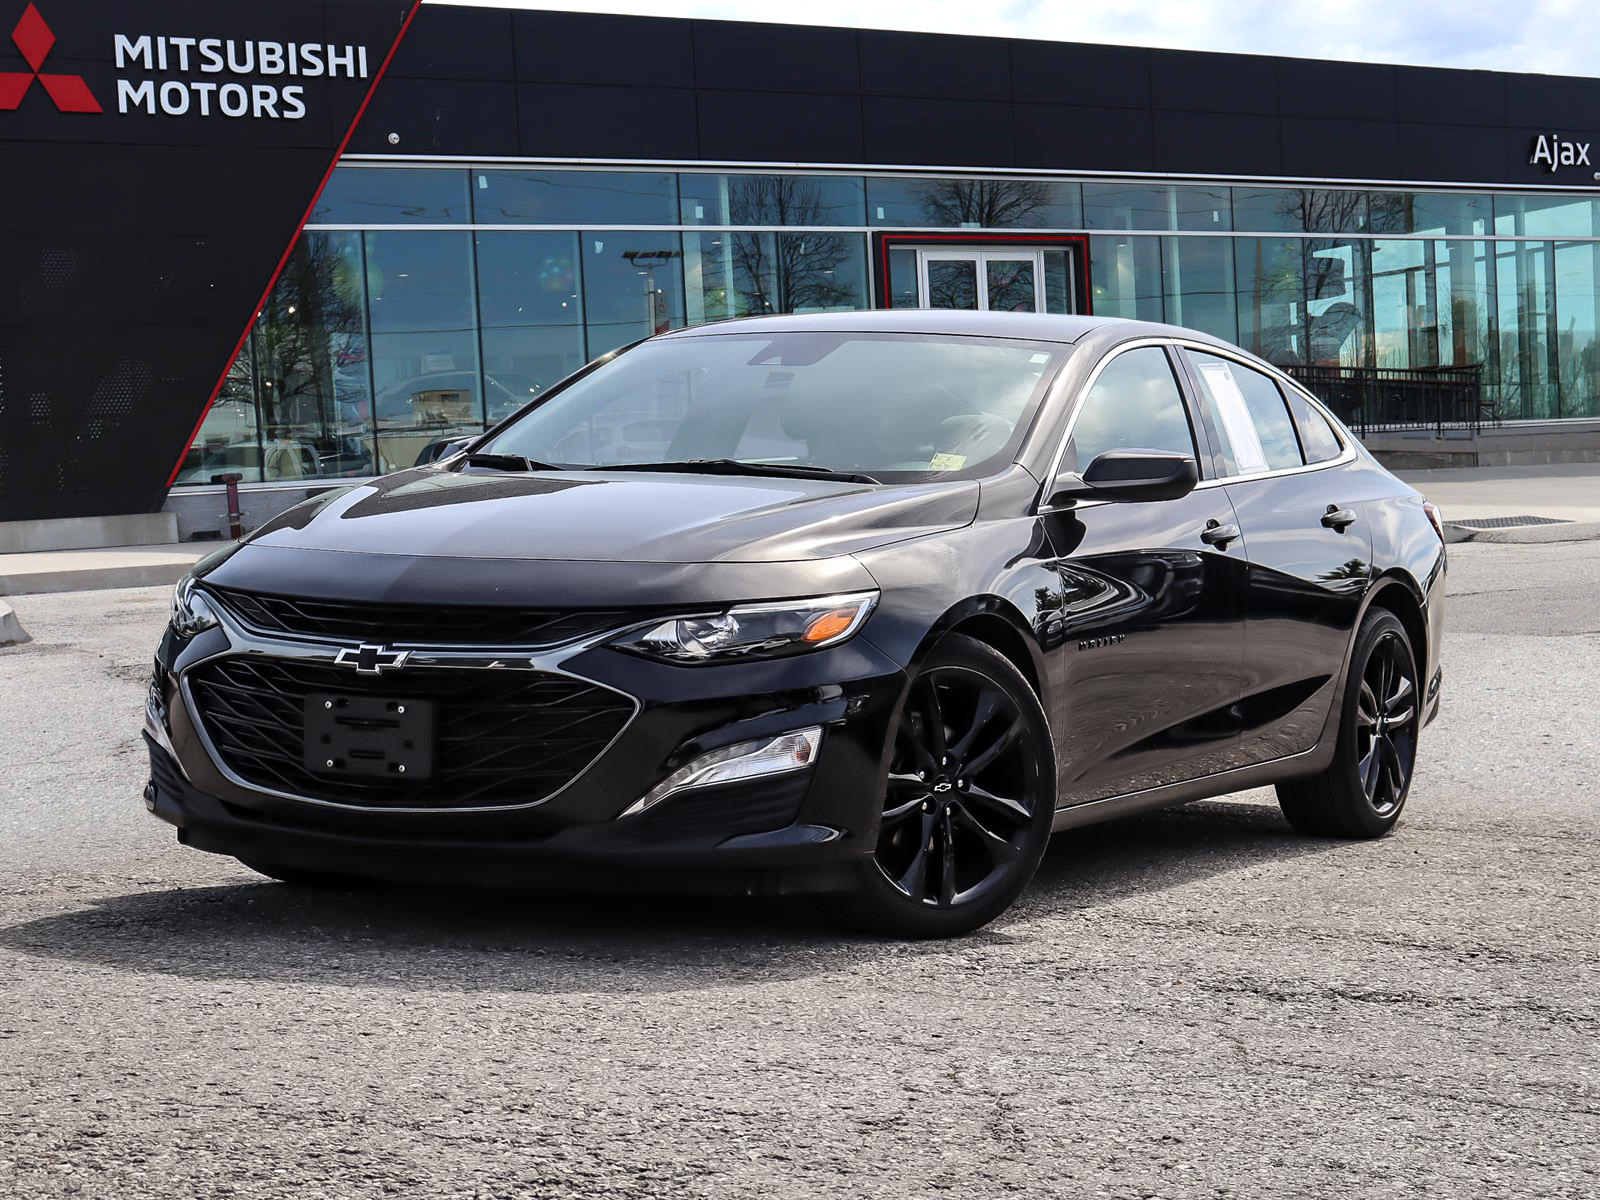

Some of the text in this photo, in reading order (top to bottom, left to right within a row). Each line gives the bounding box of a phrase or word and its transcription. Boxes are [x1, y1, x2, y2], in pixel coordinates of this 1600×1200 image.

[114, 33, 369, 79] MITSUBISHI
[116, 79, 307, 120] MOTORS
[1532, 134, 1591, 173] Ajax
